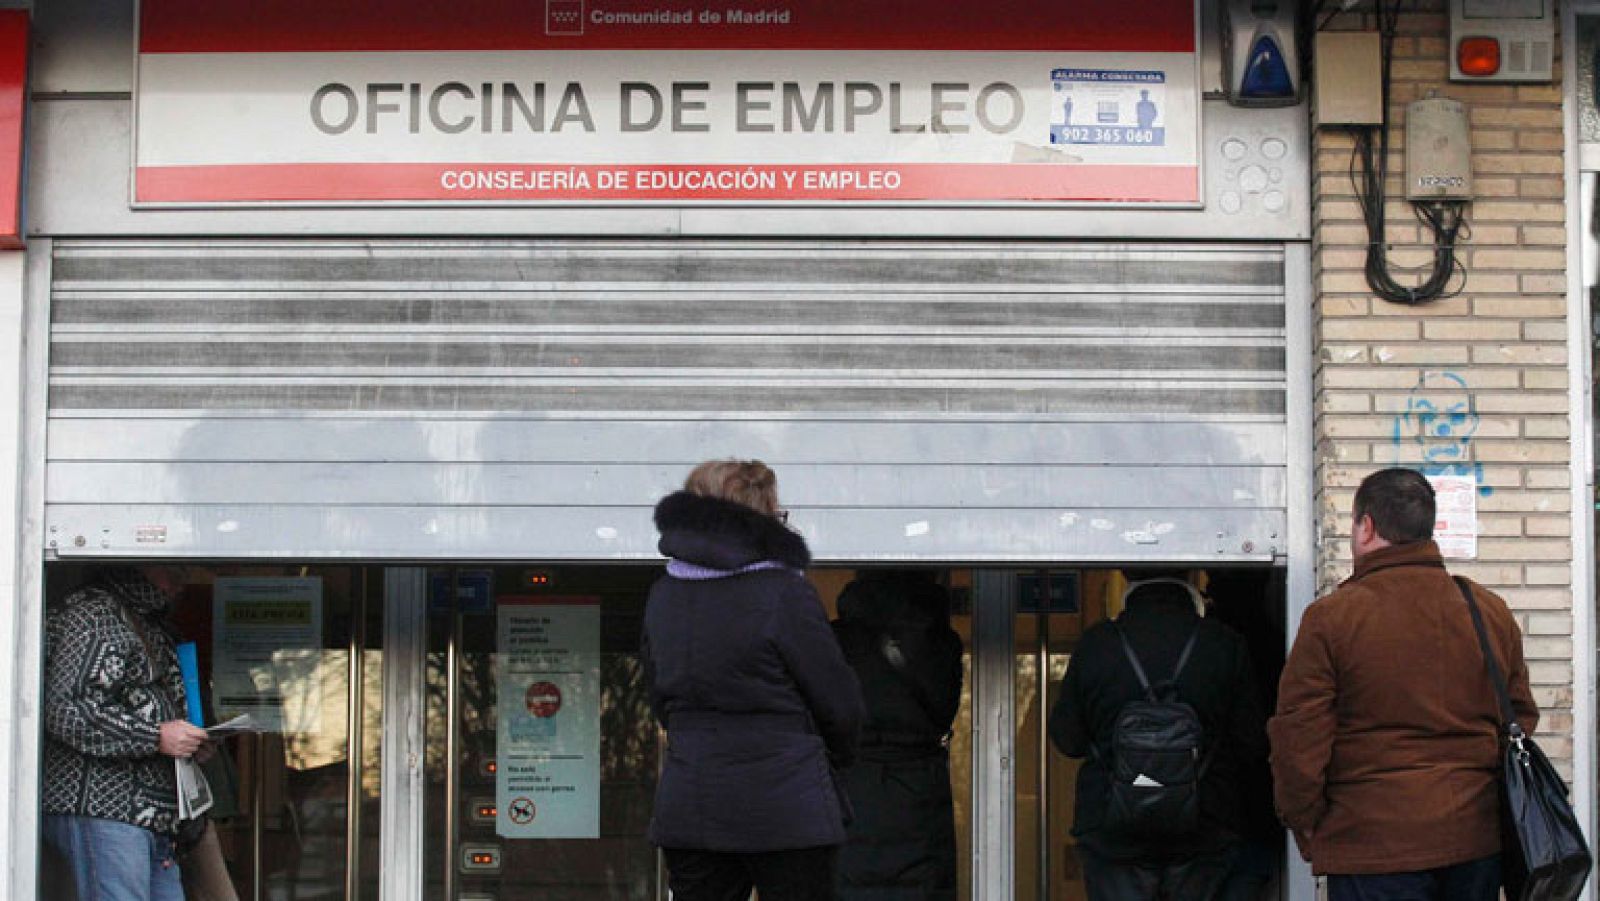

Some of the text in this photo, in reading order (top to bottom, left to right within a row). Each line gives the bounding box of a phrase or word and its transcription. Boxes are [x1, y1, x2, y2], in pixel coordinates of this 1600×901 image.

[591, 9, 790, 24] Comunidad de Madrid
[310, 81, 1025, 135] OFICINA DE EMPLEO
[1062, 128, 1153, 143] 902 365 060
[441, 167, 901, 190] CONSEJERÍA DE EDUCACIÓN Y EMPLEO
